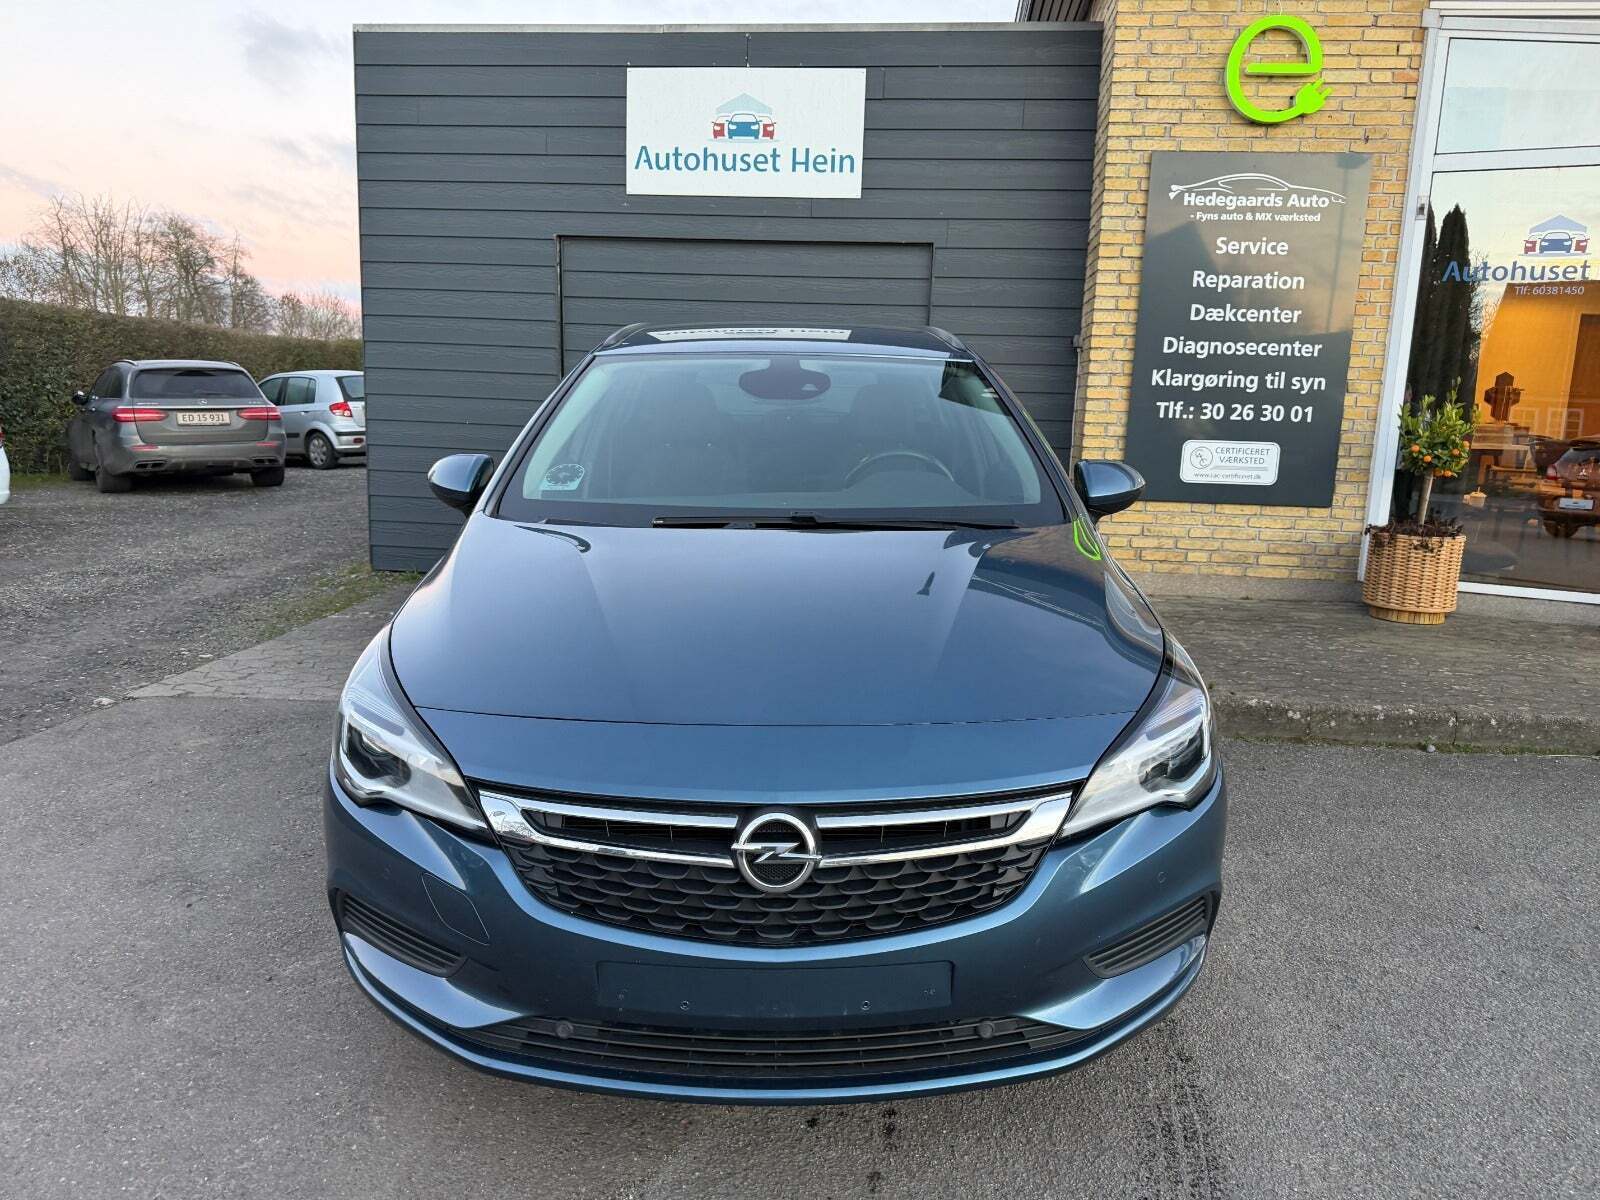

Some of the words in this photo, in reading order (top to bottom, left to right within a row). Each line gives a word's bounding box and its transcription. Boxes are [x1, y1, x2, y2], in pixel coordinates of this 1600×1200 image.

[634, 145, 781, 173] Autohuset
[791, 147, 855, 173] Hein
[1183, 192, 1283, 210] Hedegaards
[1286, 193, 1330, 208] Auto
[1196, 212, 1219, 221] Fyns
[1221, 213, 1244, 221] auto
[1245, 213, 1254, 221] &
[1255, 212, 1273, 221] MX
[1274, 213, 1321, 222] værksted
[1215, 236, 1289, 256] Service
[1442, 259, 1591, 282] Autohuset
[1192, 270, 1306, 292] Reparation
[1532, 285, 1585, 296] 60381450
[1189, 303, 1303, 324] Dækcenter
[1162, 336, 1323, 358] Diagnosecenter
[1151, 368, 1259, 393] Klargøring
[1264, 370, 1286, 390] til
[1291, 375, 1327, 395] syn
[182, 413, 195, 422] ED
[197, 413, 208, 422] 15
[209, 413, 225, 422] 931
[1156, 401, 1194, 420] Tlf.:
[1199, 402, 1225, 421] 30
[1229, 403, 1255, 422] 26
[1260, 404, 1285, 422] 30
[1290, 405, 1314, 423] 01
[1215, 446, 1271, 456] CERTIFICERET
[1219, 456, 1265, 465] VÆRKSTED
